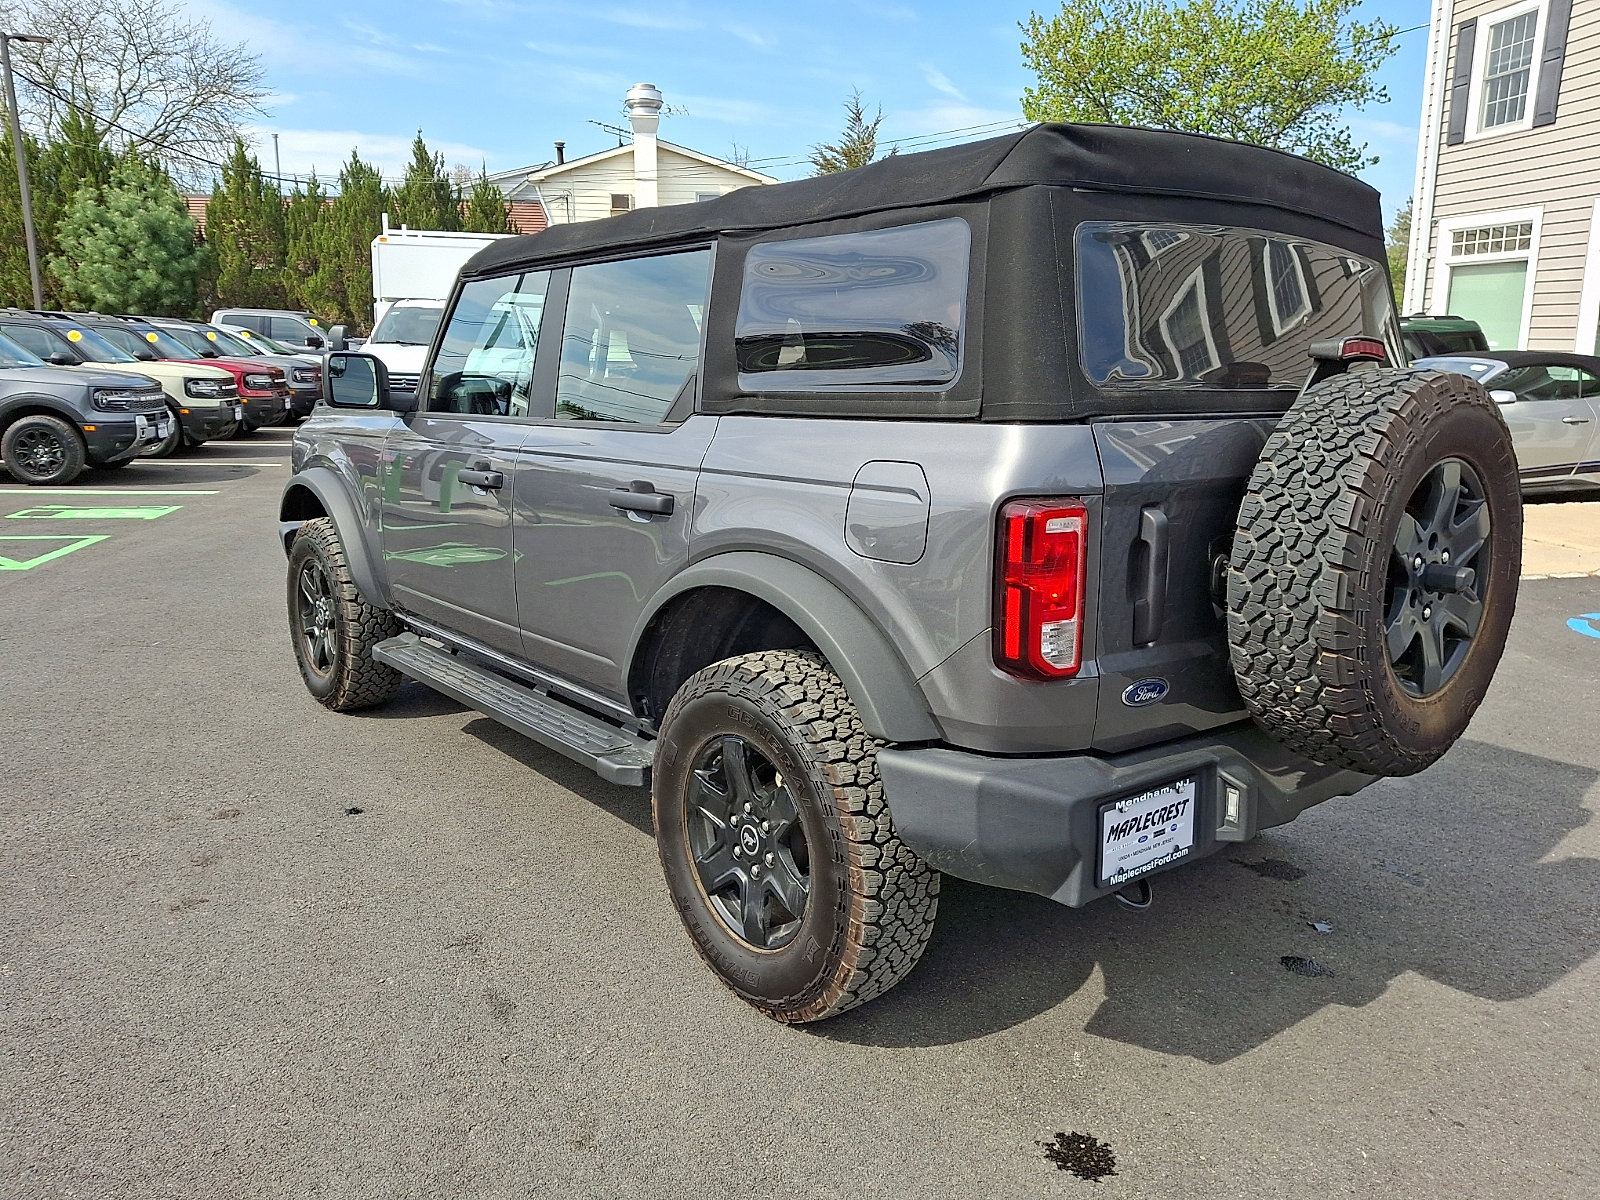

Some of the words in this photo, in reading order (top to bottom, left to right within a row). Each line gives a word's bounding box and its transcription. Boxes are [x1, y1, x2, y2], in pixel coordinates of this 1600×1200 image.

[1134, 686, 1160, 702] Ford
[726, 704, 813, 812] GENERAL
[1115, 786, 1173, 810] Mendham,
[1176, 778, 1190, 789] NJ
[1106, 798, 1190, 844] MAPLECREST
[1110, 847, 1189, 886] MaplecrestFord.com
